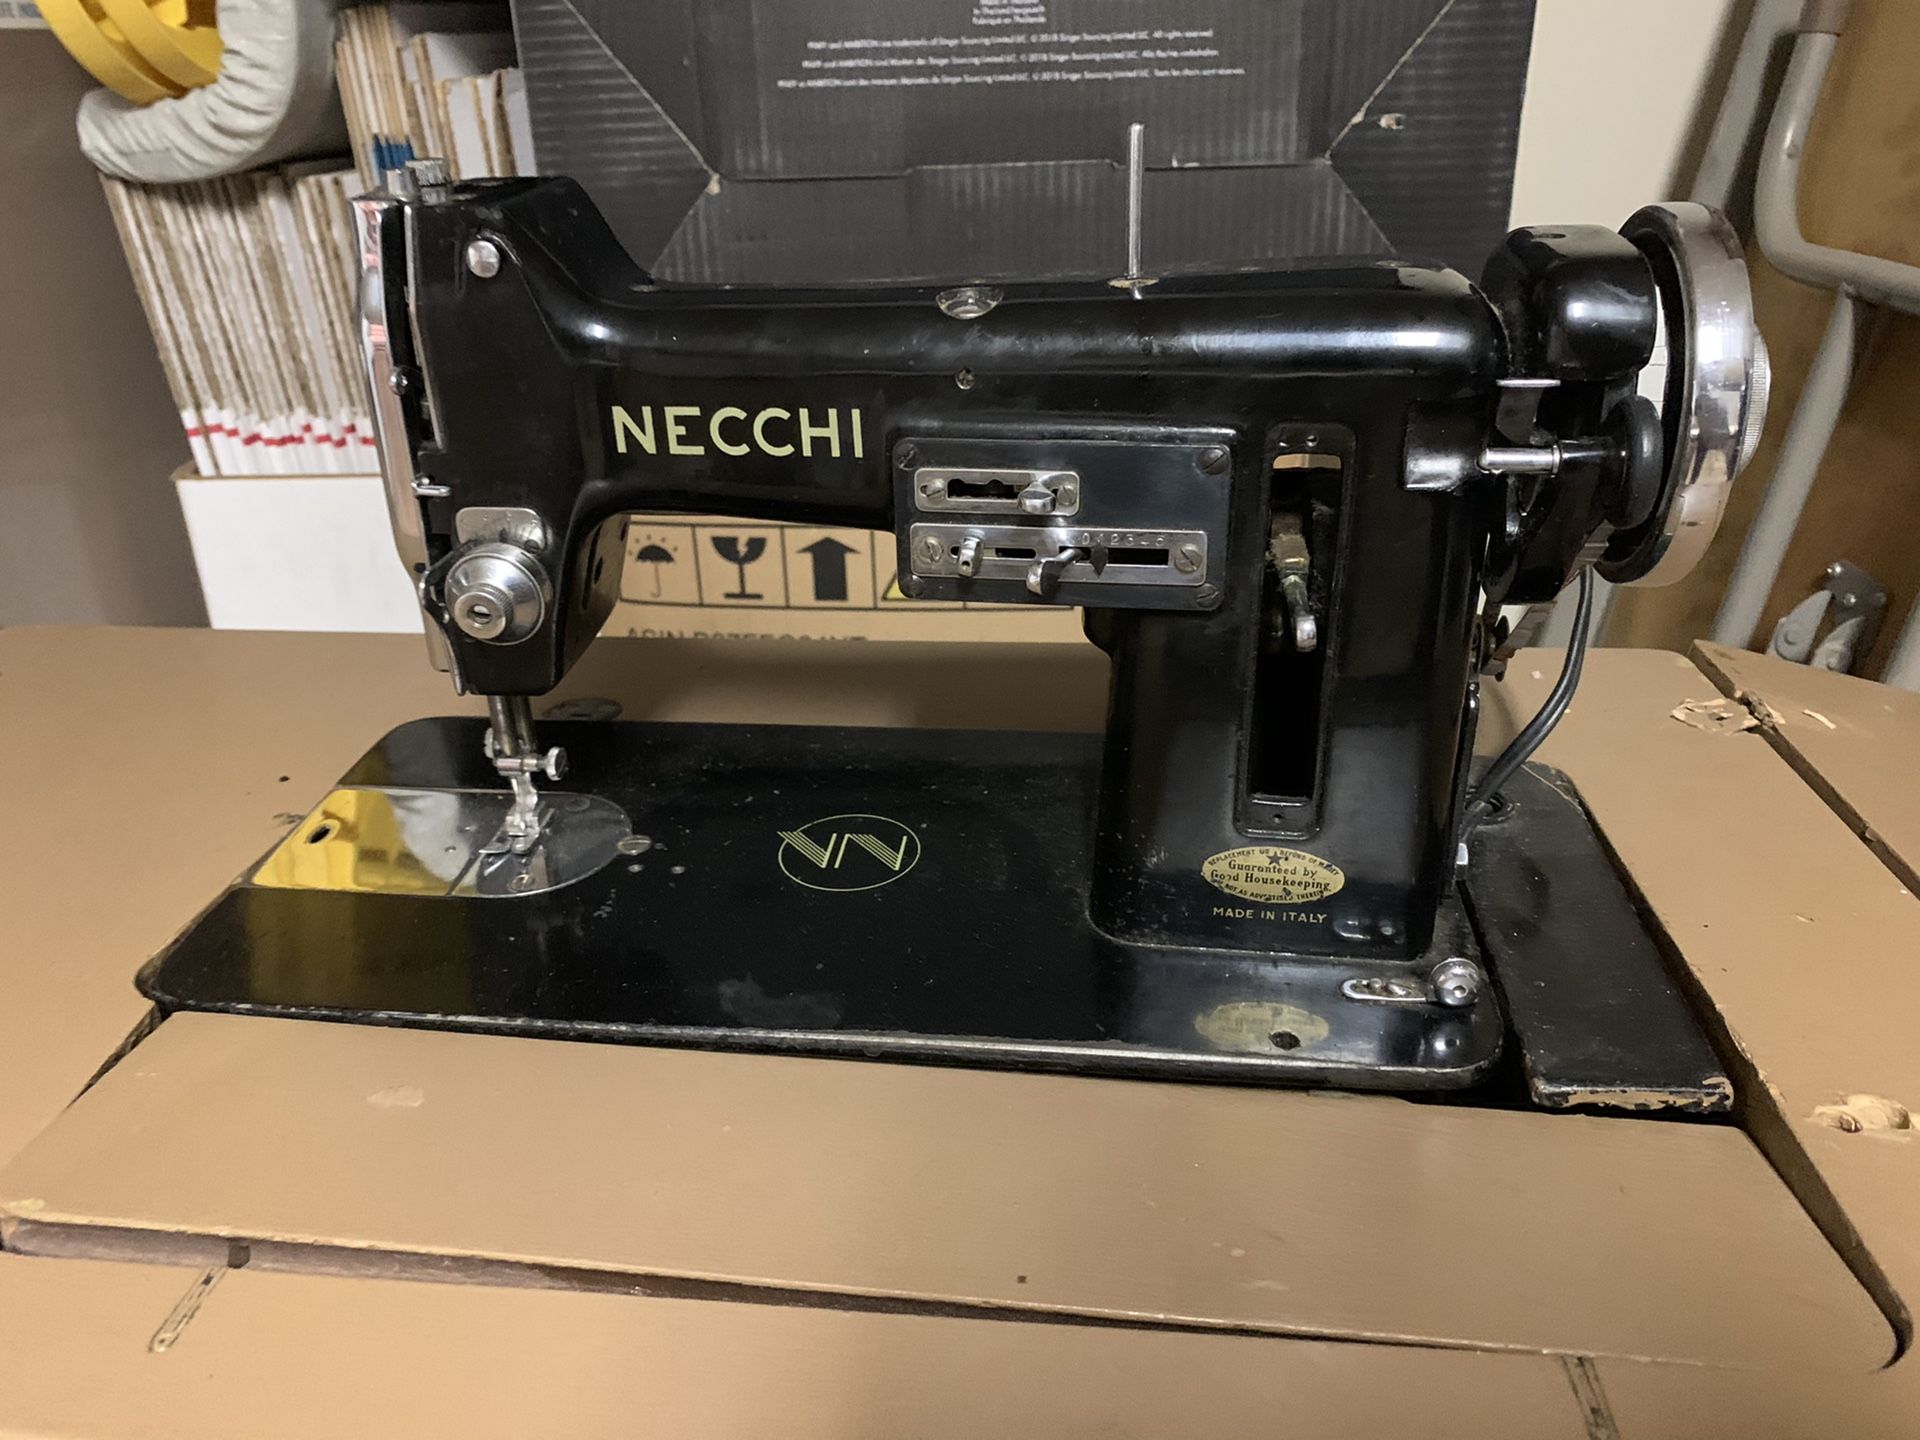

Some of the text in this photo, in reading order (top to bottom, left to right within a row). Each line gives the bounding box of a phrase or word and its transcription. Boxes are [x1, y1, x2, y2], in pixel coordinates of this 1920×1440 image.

[611, 405, 864, 458] NECCHI
[1228, 859, 1318, 879] Guaranteed by
[1210, 869, 1331, 892] Good Housekeeping
[1213, 907, 1328, 924] MADE IN ITALY
